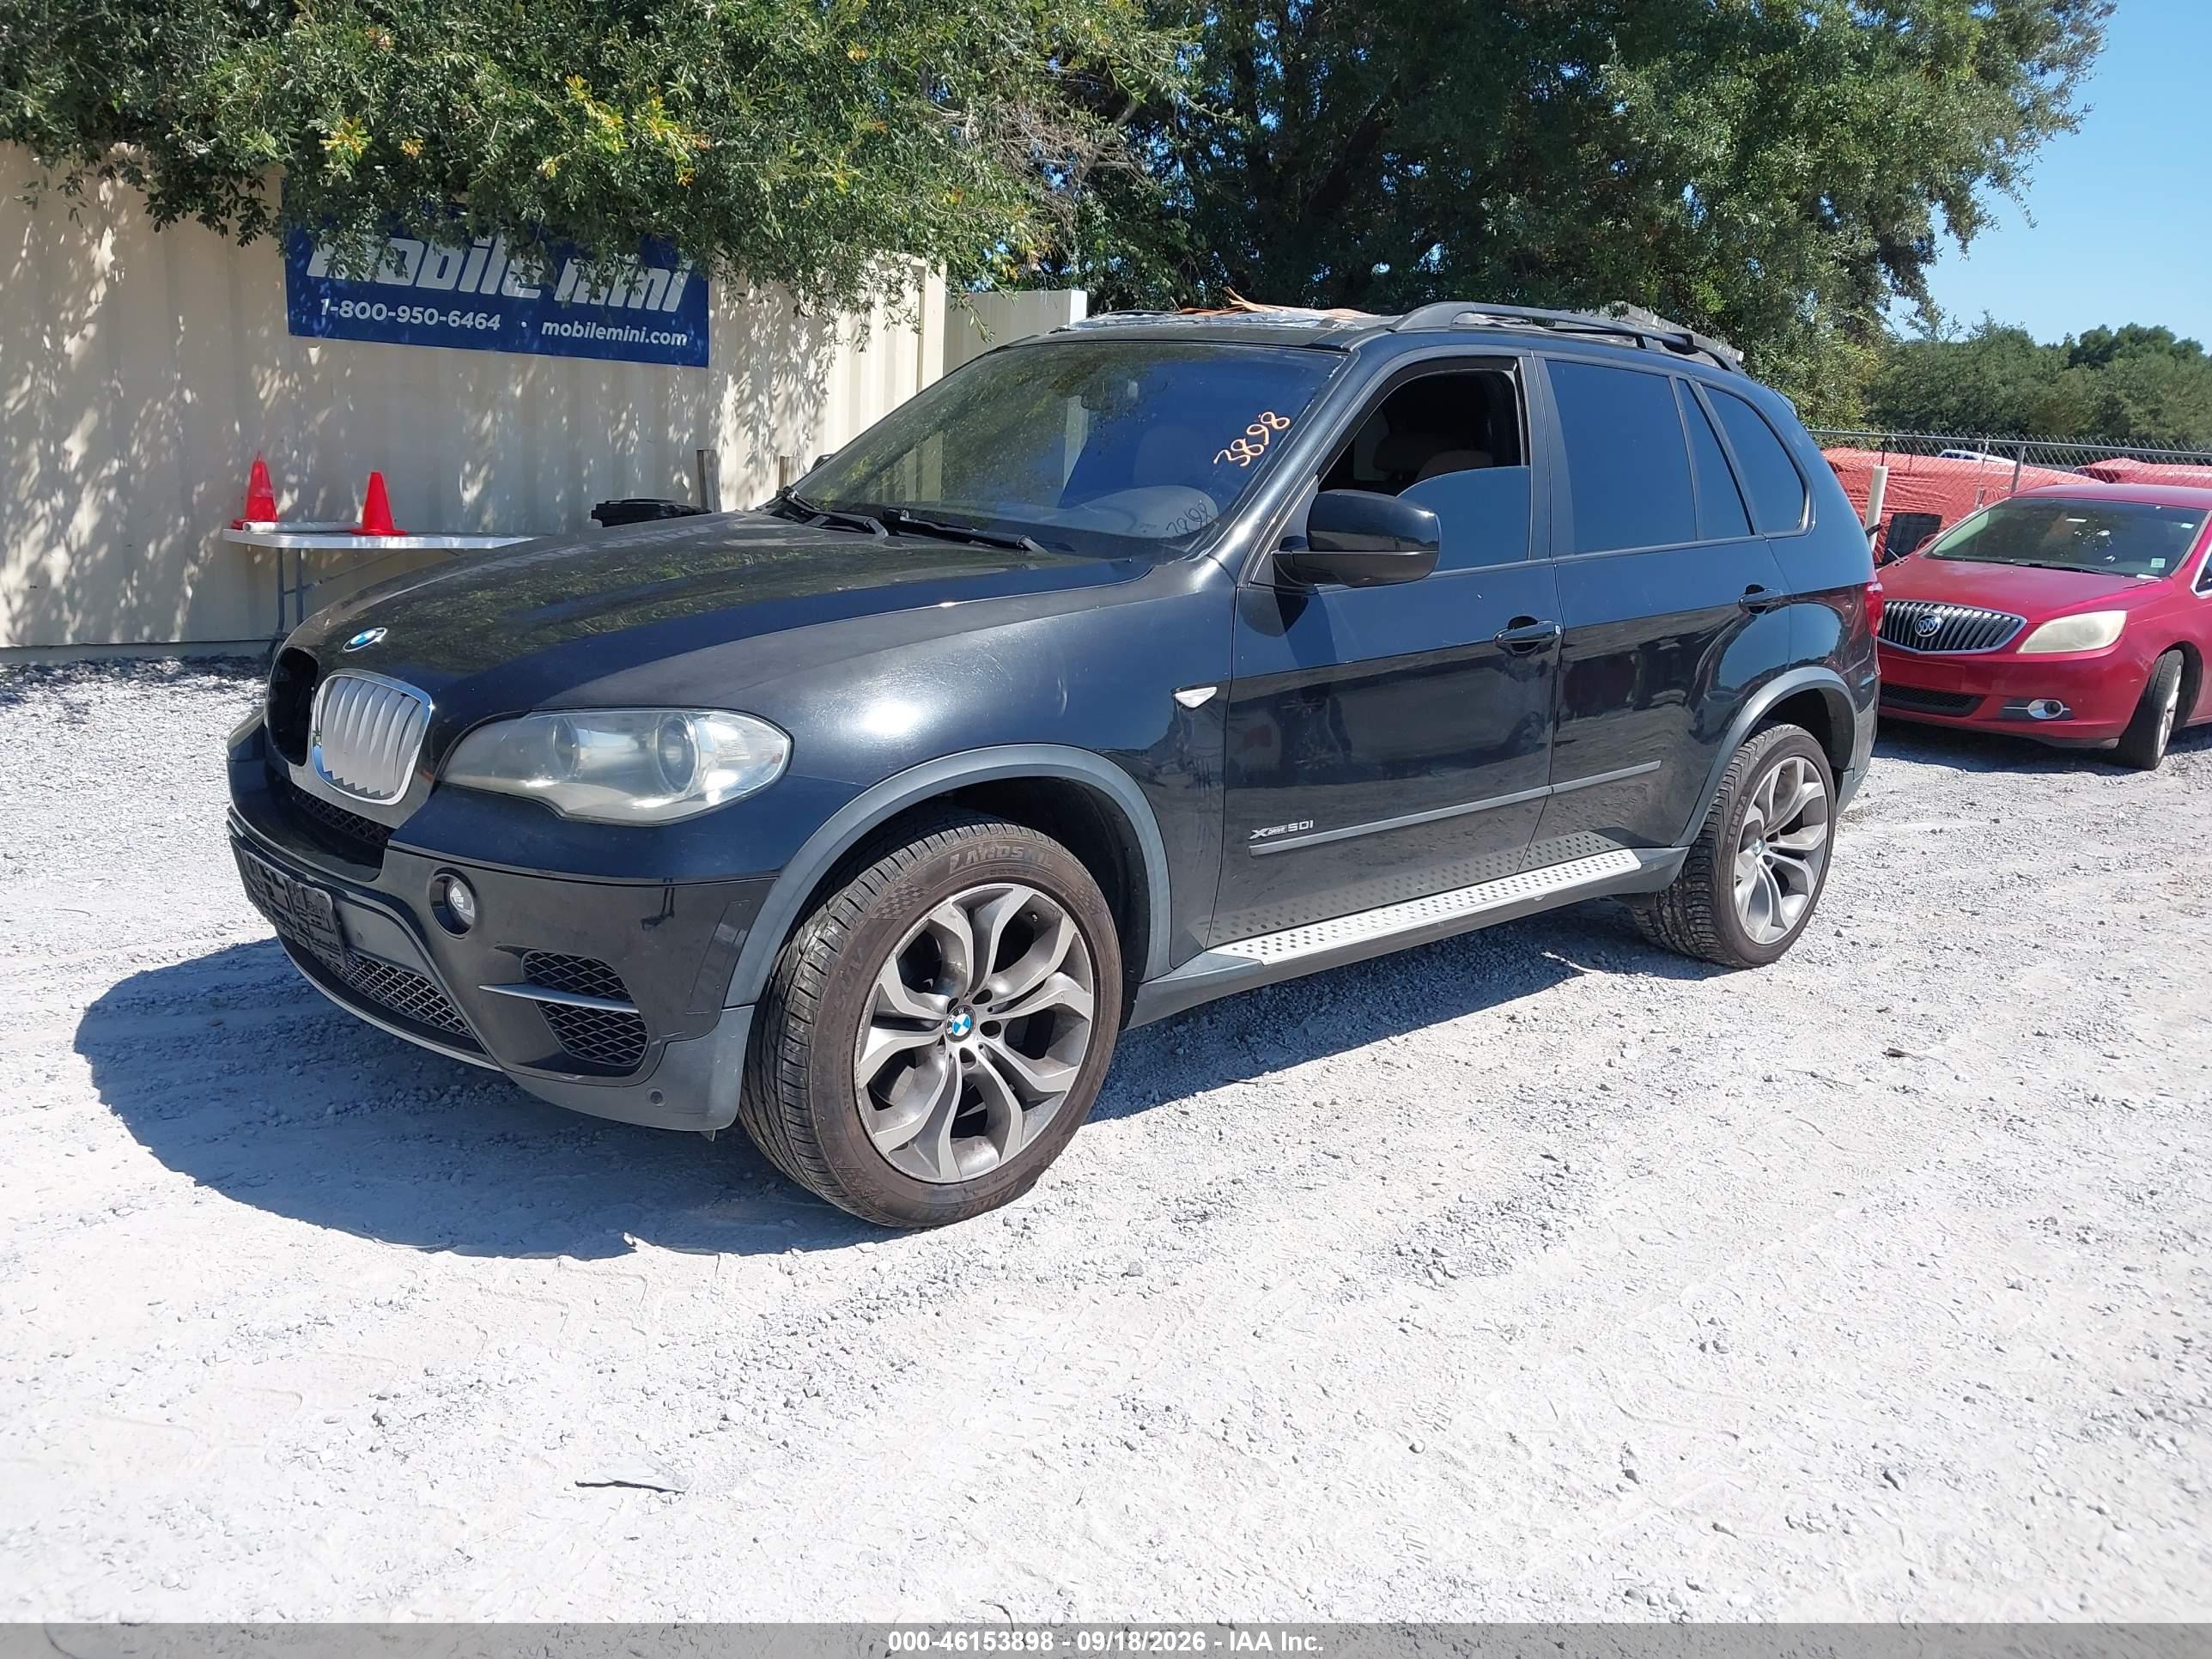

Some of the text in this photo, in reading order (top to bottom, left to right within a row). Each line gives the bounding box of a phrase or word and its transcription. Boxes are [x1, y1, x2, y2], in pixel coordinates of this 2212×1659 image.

[320, 298, 687, 346] 1-800-950-6464 mobilemini.com
[1213, 411, 1290, 466] 3898
